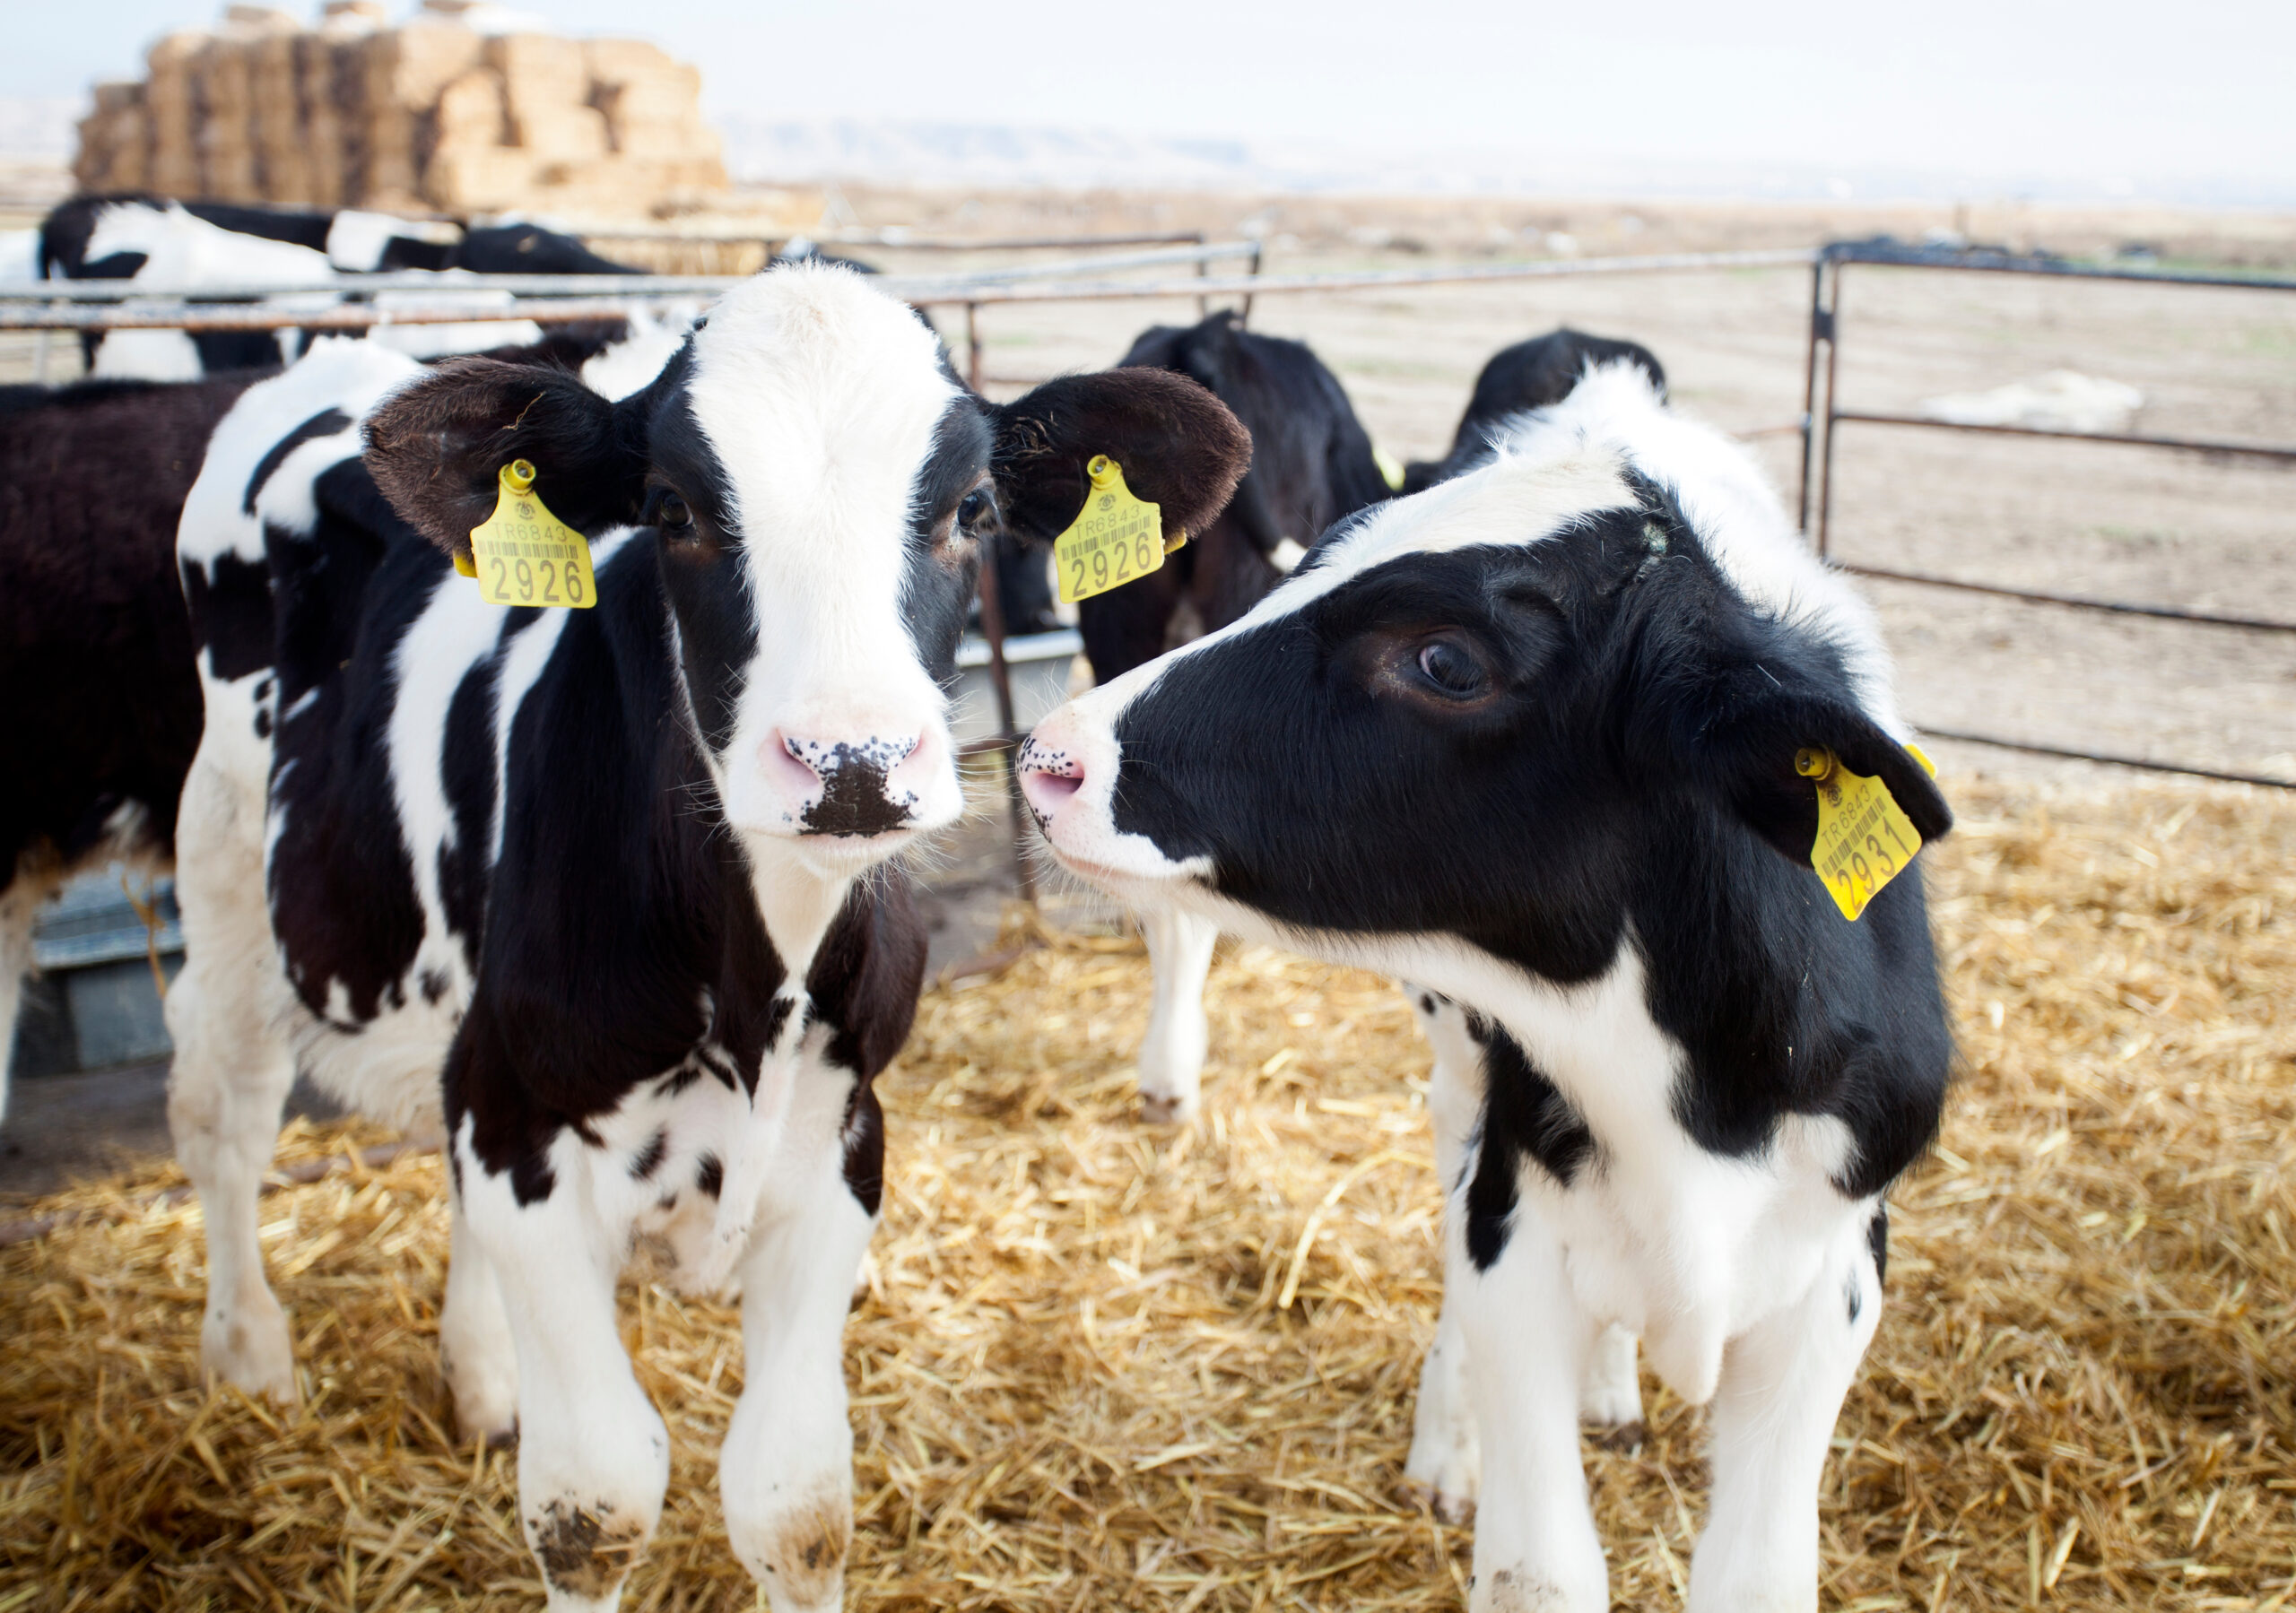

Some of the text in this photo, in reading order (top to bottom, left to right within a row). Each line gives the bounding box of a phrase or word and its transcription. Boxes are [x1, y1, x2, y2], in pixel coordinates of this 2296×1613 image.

[491, 522, 568, 542] TR6843
[1075, 504, 1140, 540] TR6843
[491, 557, 583, 603] 2926
[1071, 532, 1152, 598] 2926
[1822, 785, 1871, 848] TR6843
[1837, 817, 1912, 915] 2931
